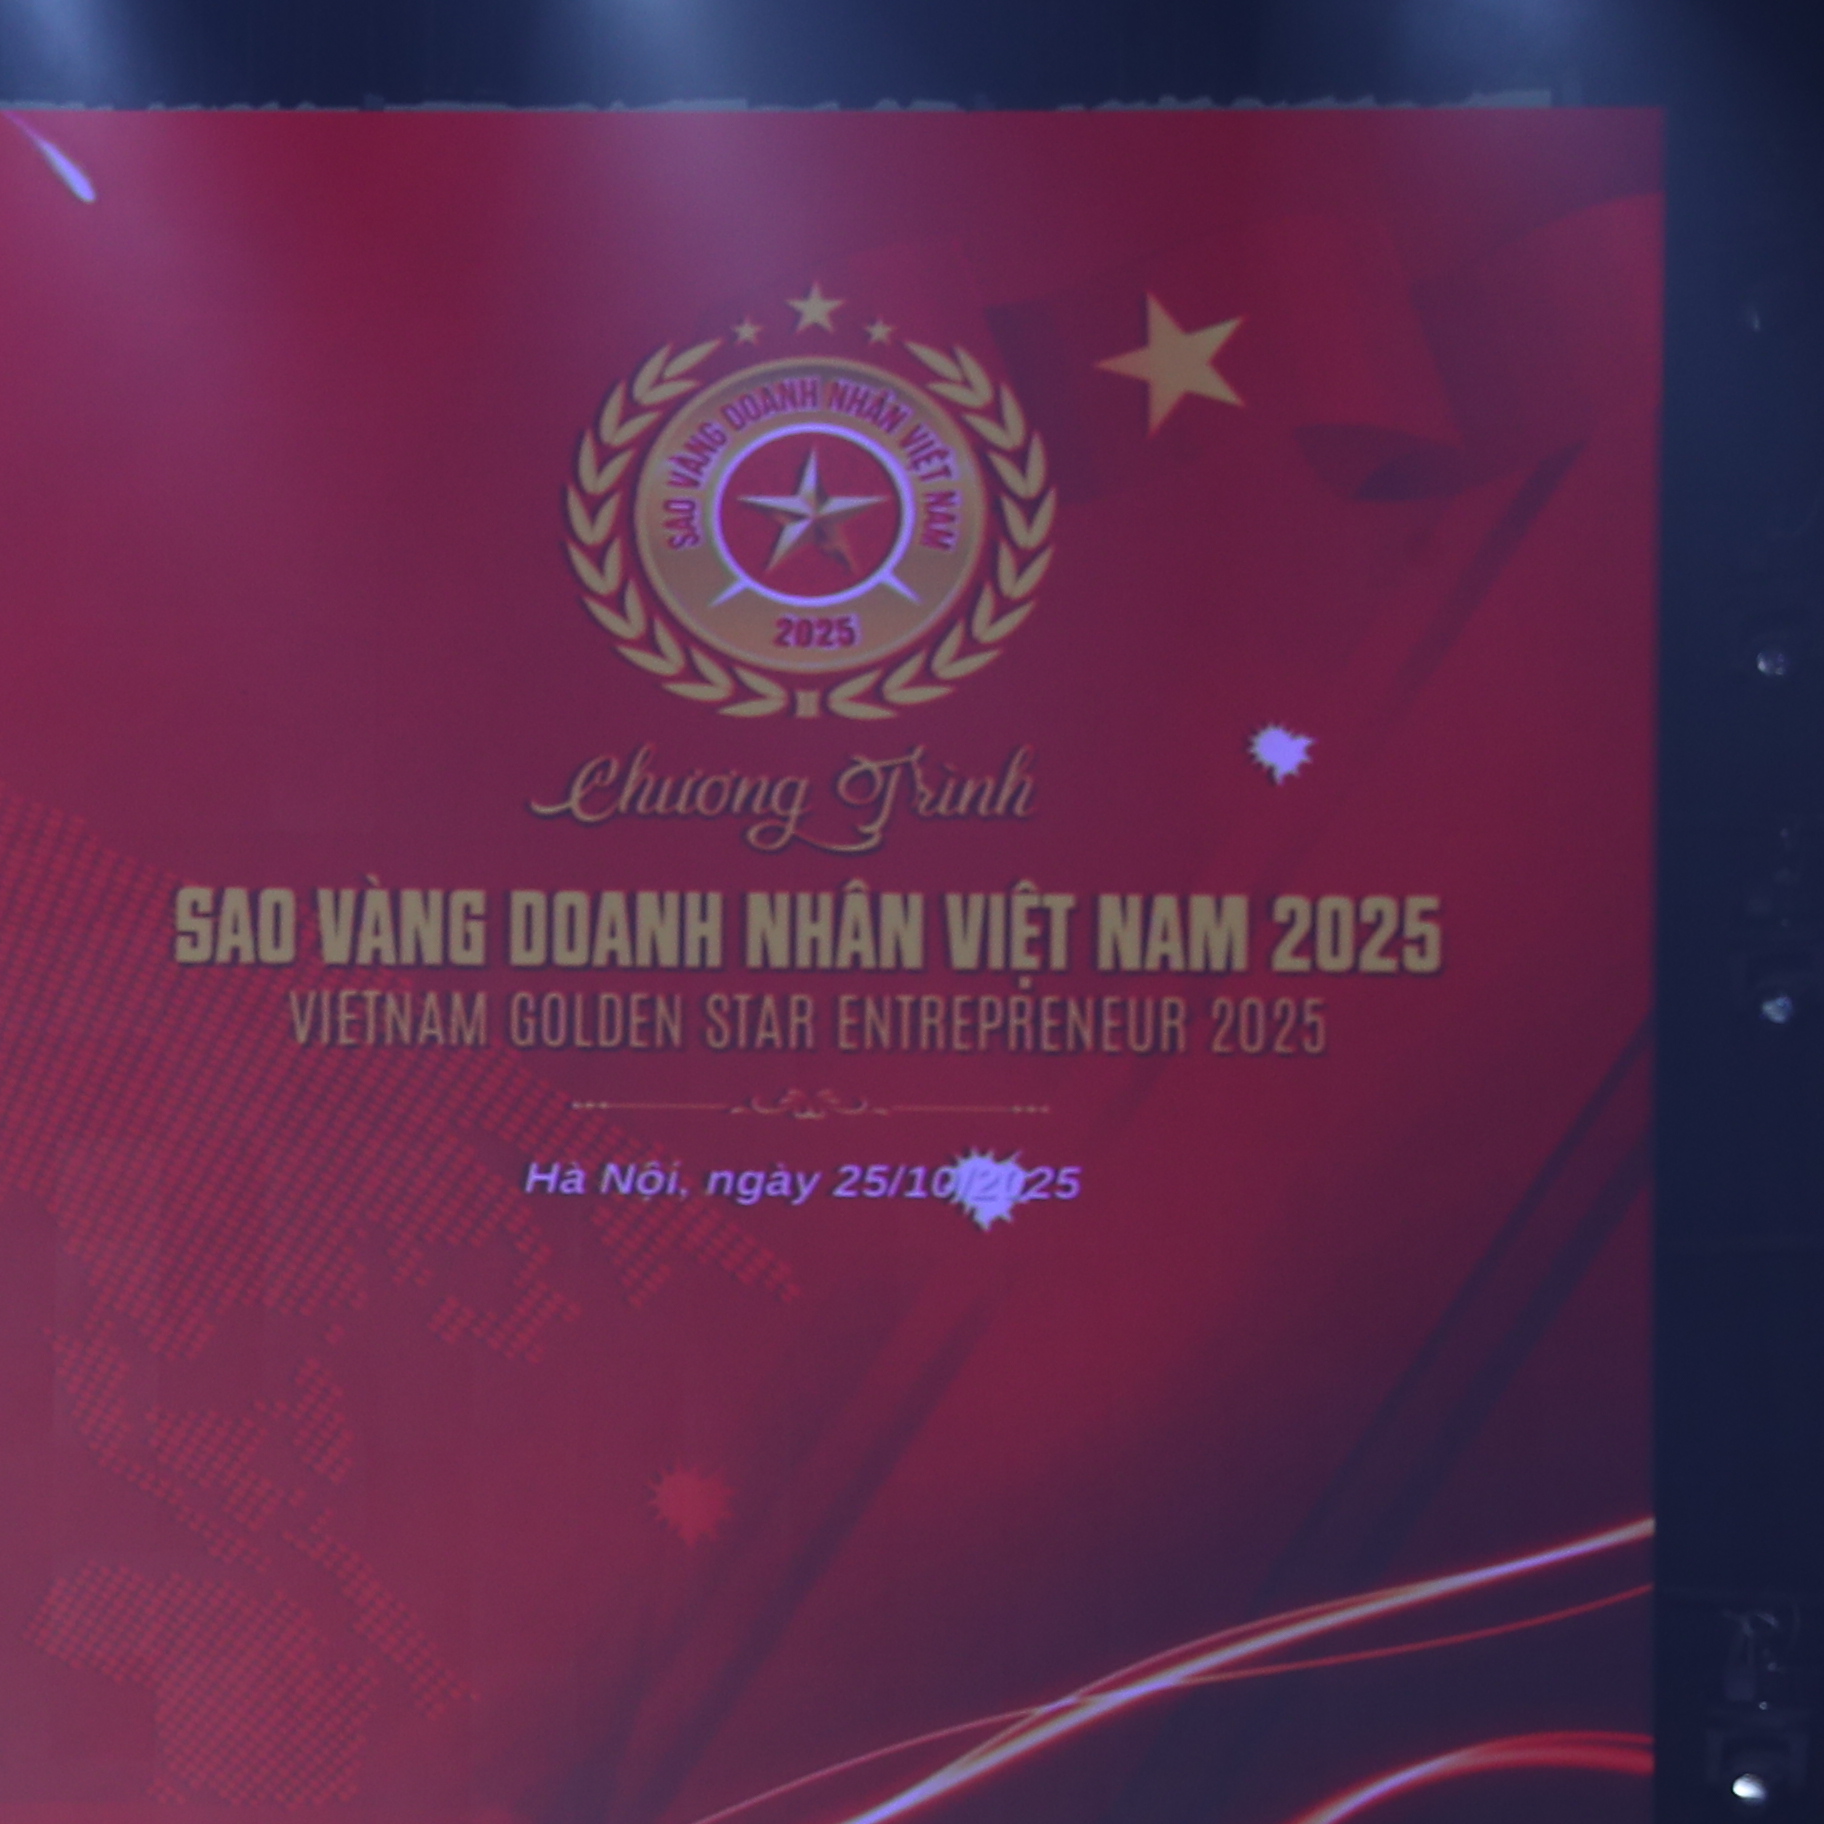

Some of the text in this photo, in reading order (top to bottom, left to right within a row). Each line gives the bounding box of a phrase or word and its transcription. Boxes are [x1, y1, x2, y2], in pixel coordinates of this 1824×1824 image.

[921, 490, 959, 551] NAM
[772, 613, 859, 648] 2025
[530, 741, 1036, 851] Chương Trình
[175, 873, 1442, 990] SAO VÀNG DOANH NHÂN VIỆT NAM 2025
[289, 989, 1326, 1055] VIETNAM GOLDEN STAR ENTREPRENEUR 2025
[525, 1161, 584, 1195] Hà
[707, 1163, 820, 1205] ngày
